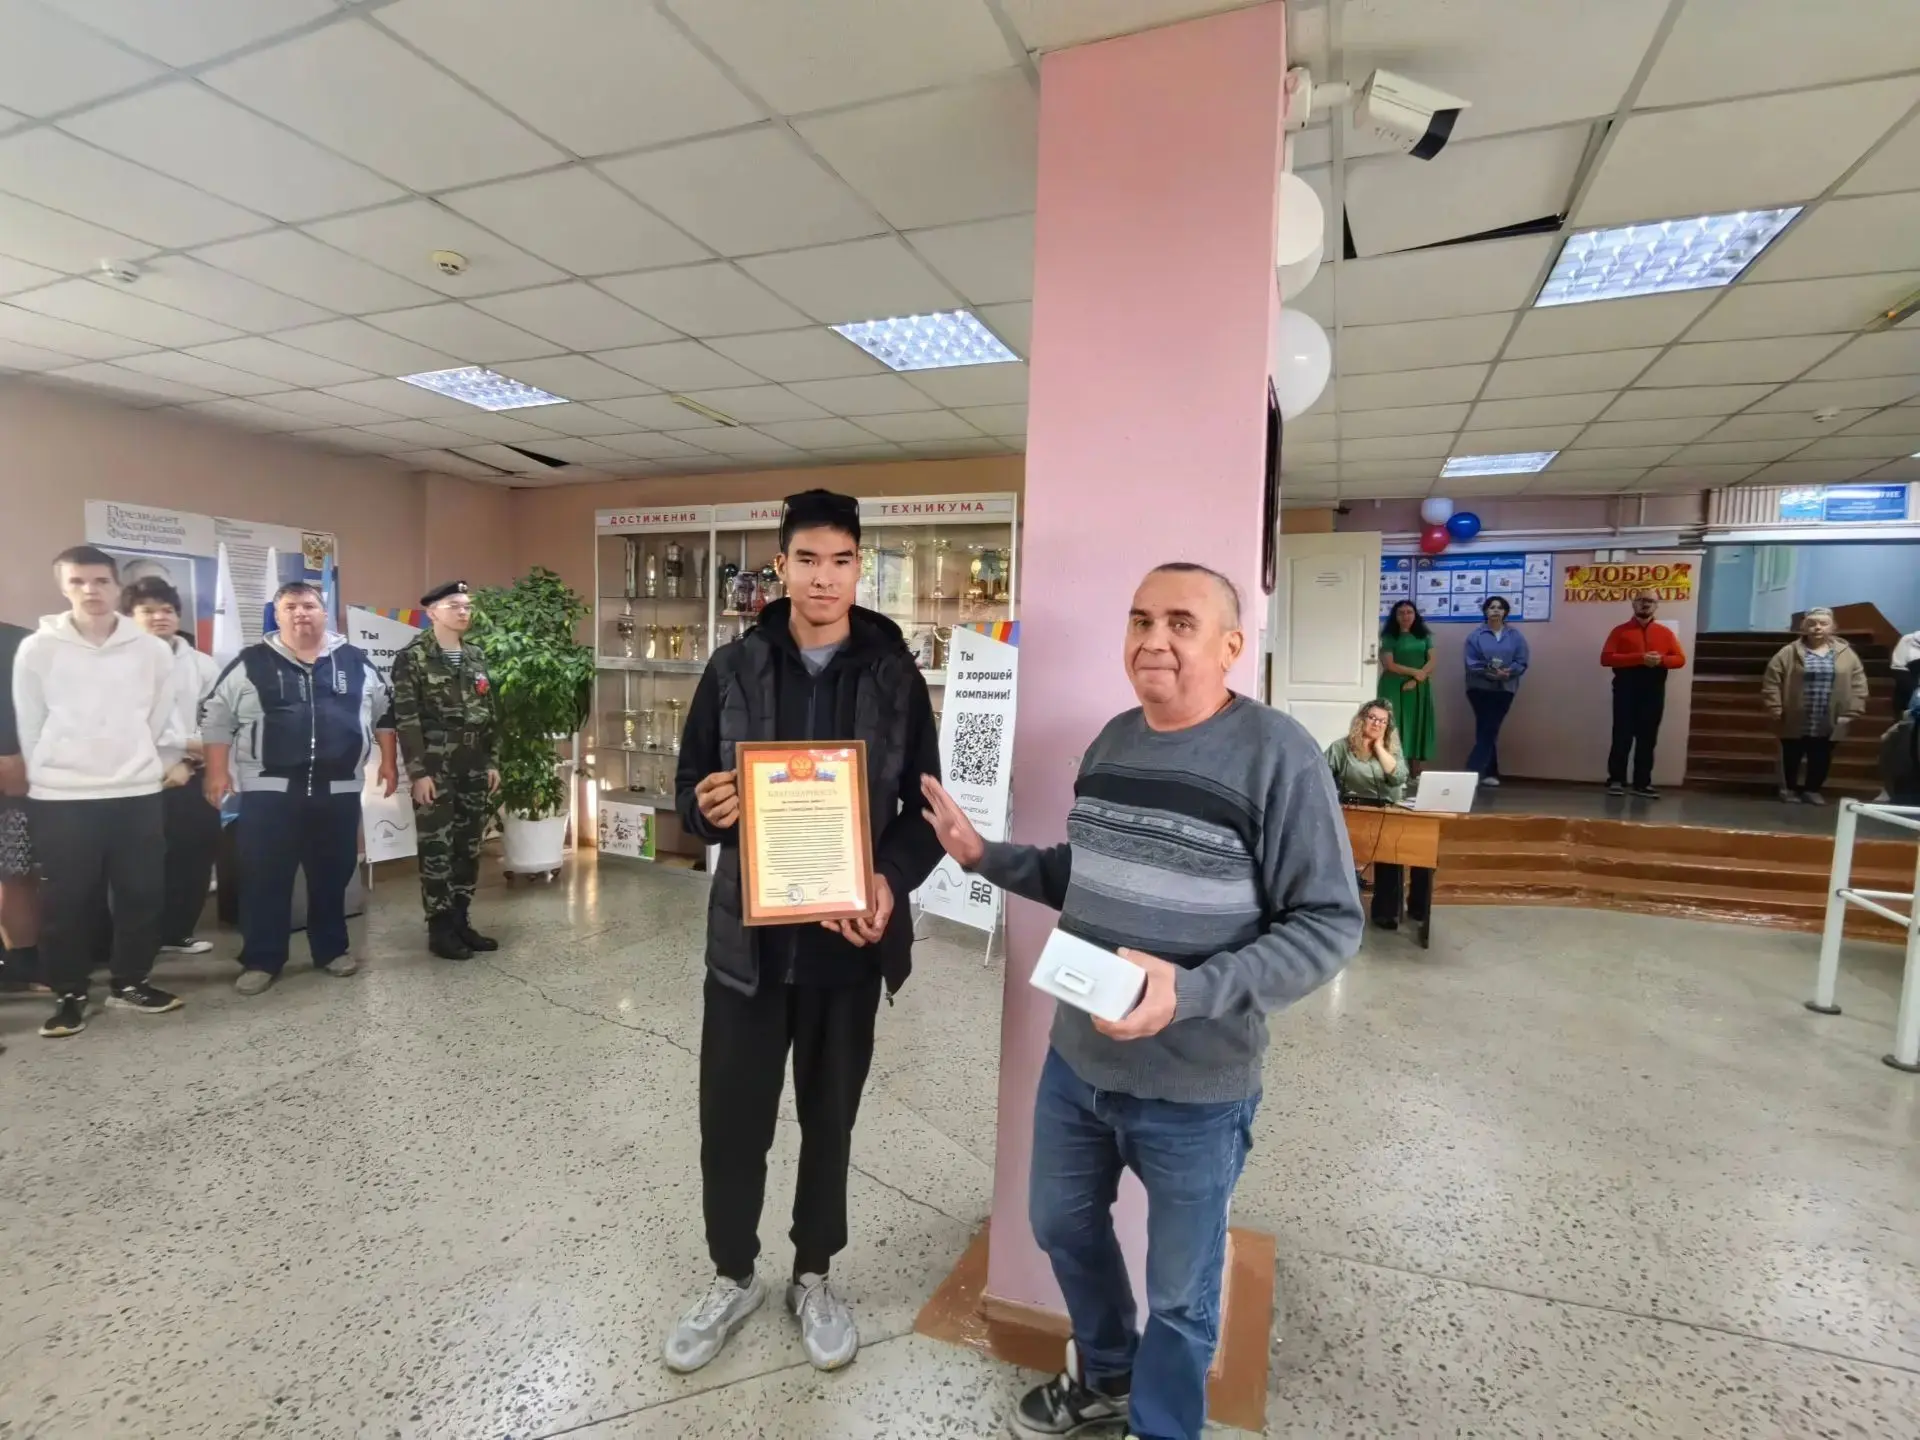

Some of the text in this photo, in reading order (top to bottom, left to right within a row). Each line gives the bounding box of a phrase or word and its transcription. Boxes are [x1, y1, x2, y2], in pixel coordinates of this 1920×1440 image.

[611, 502, 985, 525] ДОСТИЖЕНИЯ НАШ ТЕХНИКУМА
[1583, 564, 1670, 584] ДОБРО
[360, 630, 380, 640] Ты
[960, 651, 974, 661] Ты
[957, 669, 1013, 684] в хорошей
[955, 689, 1011, 700] компании!
